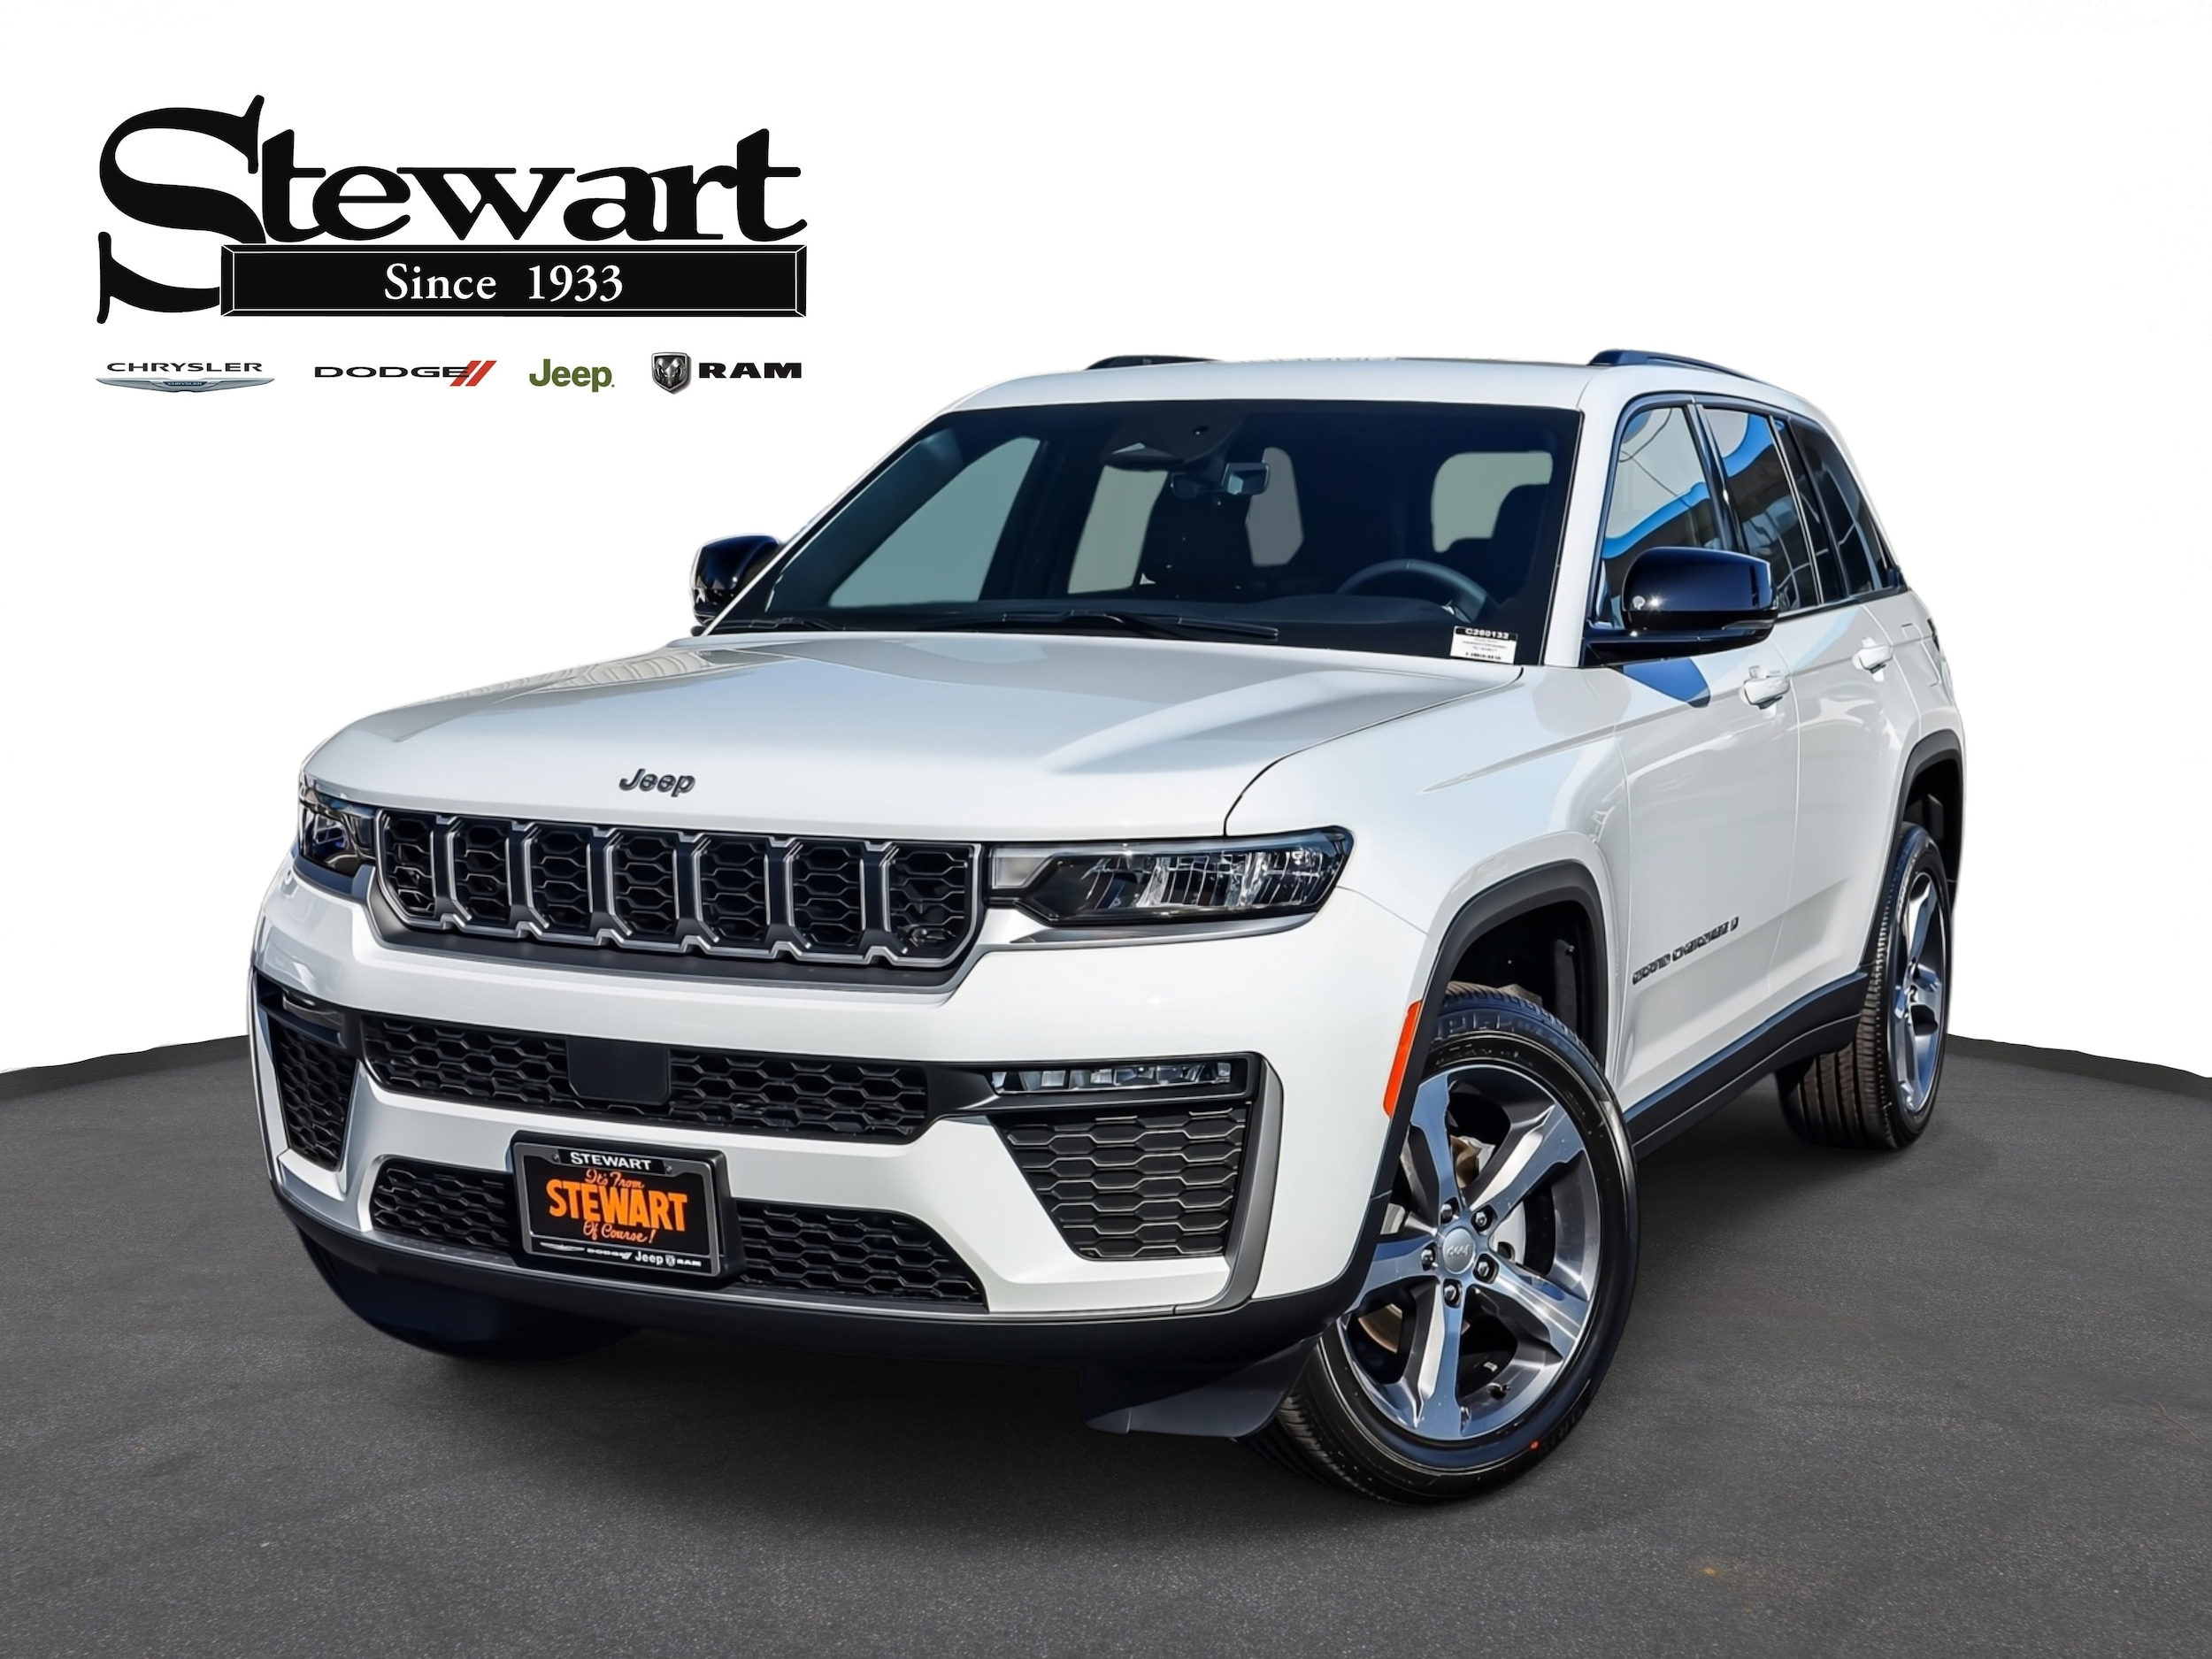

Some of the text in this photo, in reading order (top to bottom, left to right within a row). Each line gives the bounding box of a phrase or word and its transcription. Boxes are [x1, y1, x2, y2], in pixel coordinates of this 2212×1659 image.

[618, 768, 695, 798] Jeep
[571, 1152, 652, 1171] STEWART
[585, 1169, 645, 1188] It's From
[546, 1179, 688, 1232] STEWART
[582, 1221, 598, 1240] Of
[634, 1251, 664, 1265] Jeep
[677, 1258, 702, 1267] RAM
